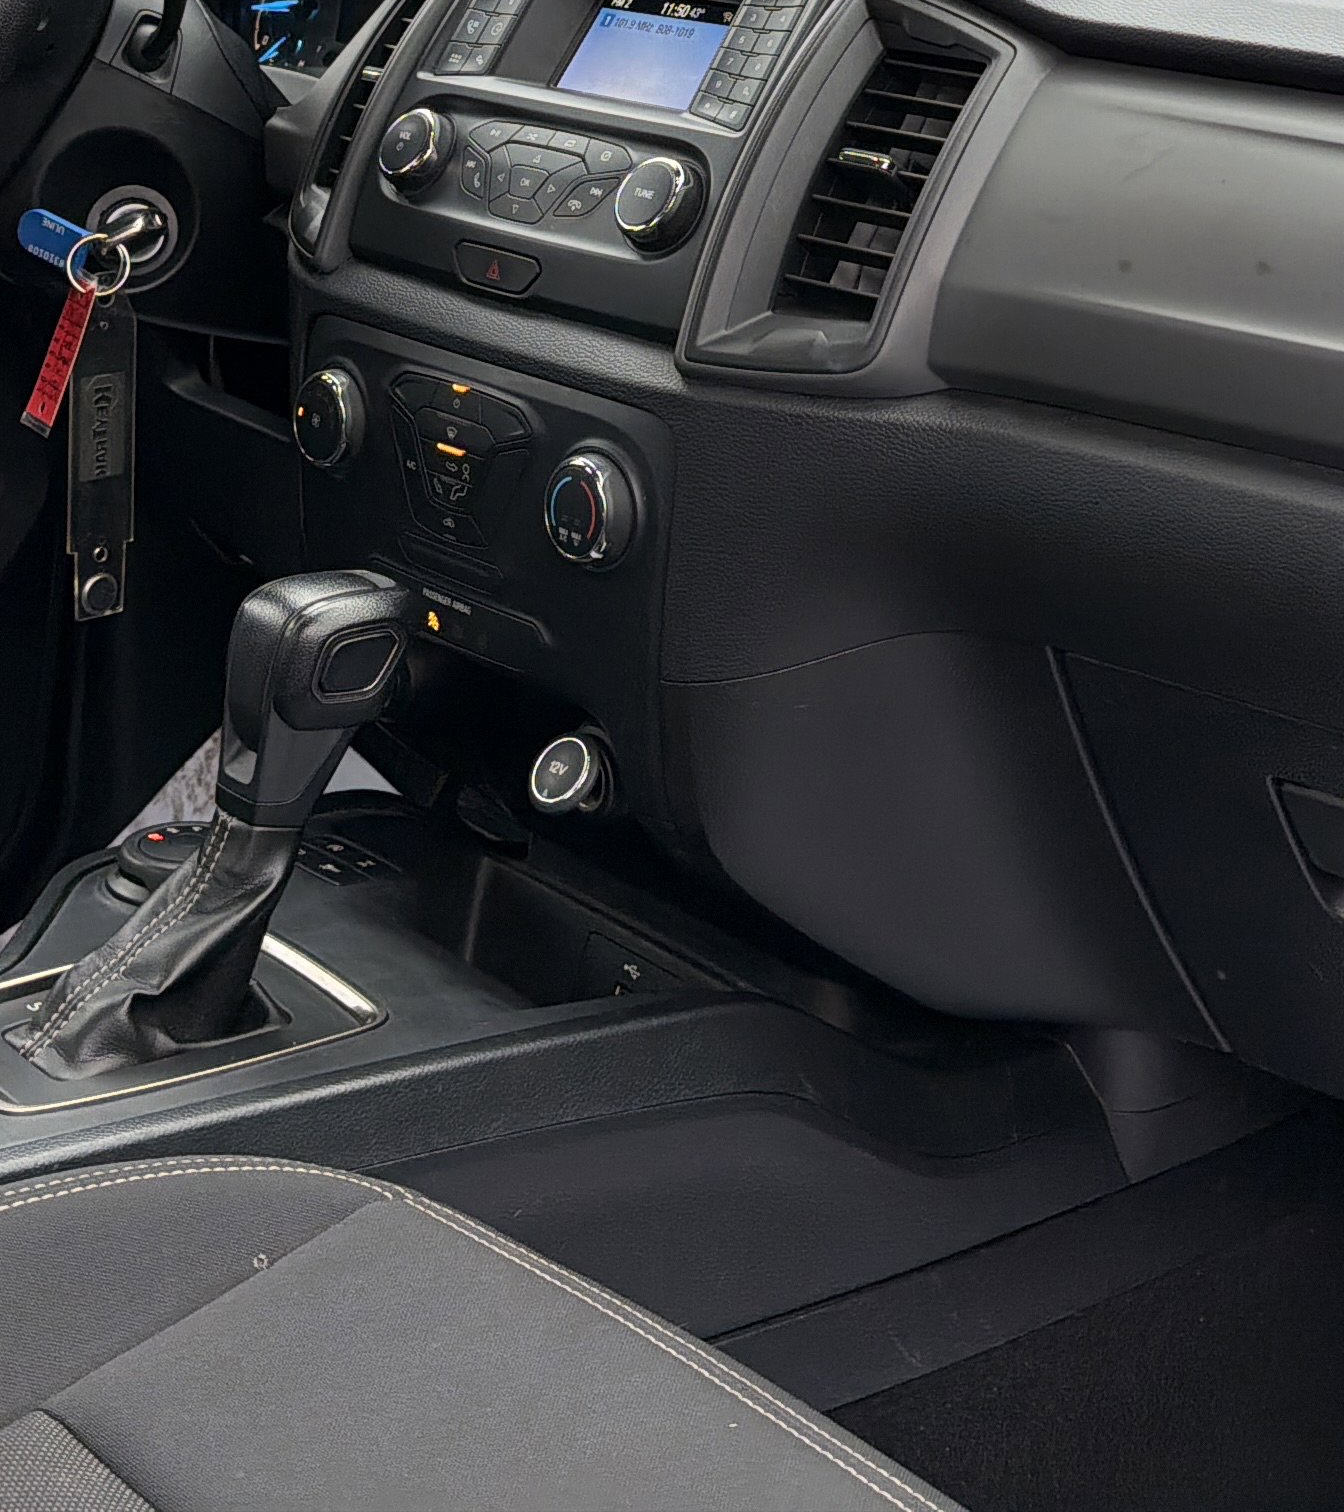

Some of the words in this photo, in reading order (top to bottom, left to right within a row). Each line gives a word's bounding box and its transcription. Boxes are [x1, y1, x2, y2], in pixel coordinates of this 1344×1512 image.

[660, 1, 691, 18] 11:50
[633, 187, 655, 200] TUNE
[41, 216, 65, 236] ULINE
[422, 587, 452, 607] PASSENGER
[451, 599, 472, 616] AIRBAG
[548, 760, 569, 776] 12V
